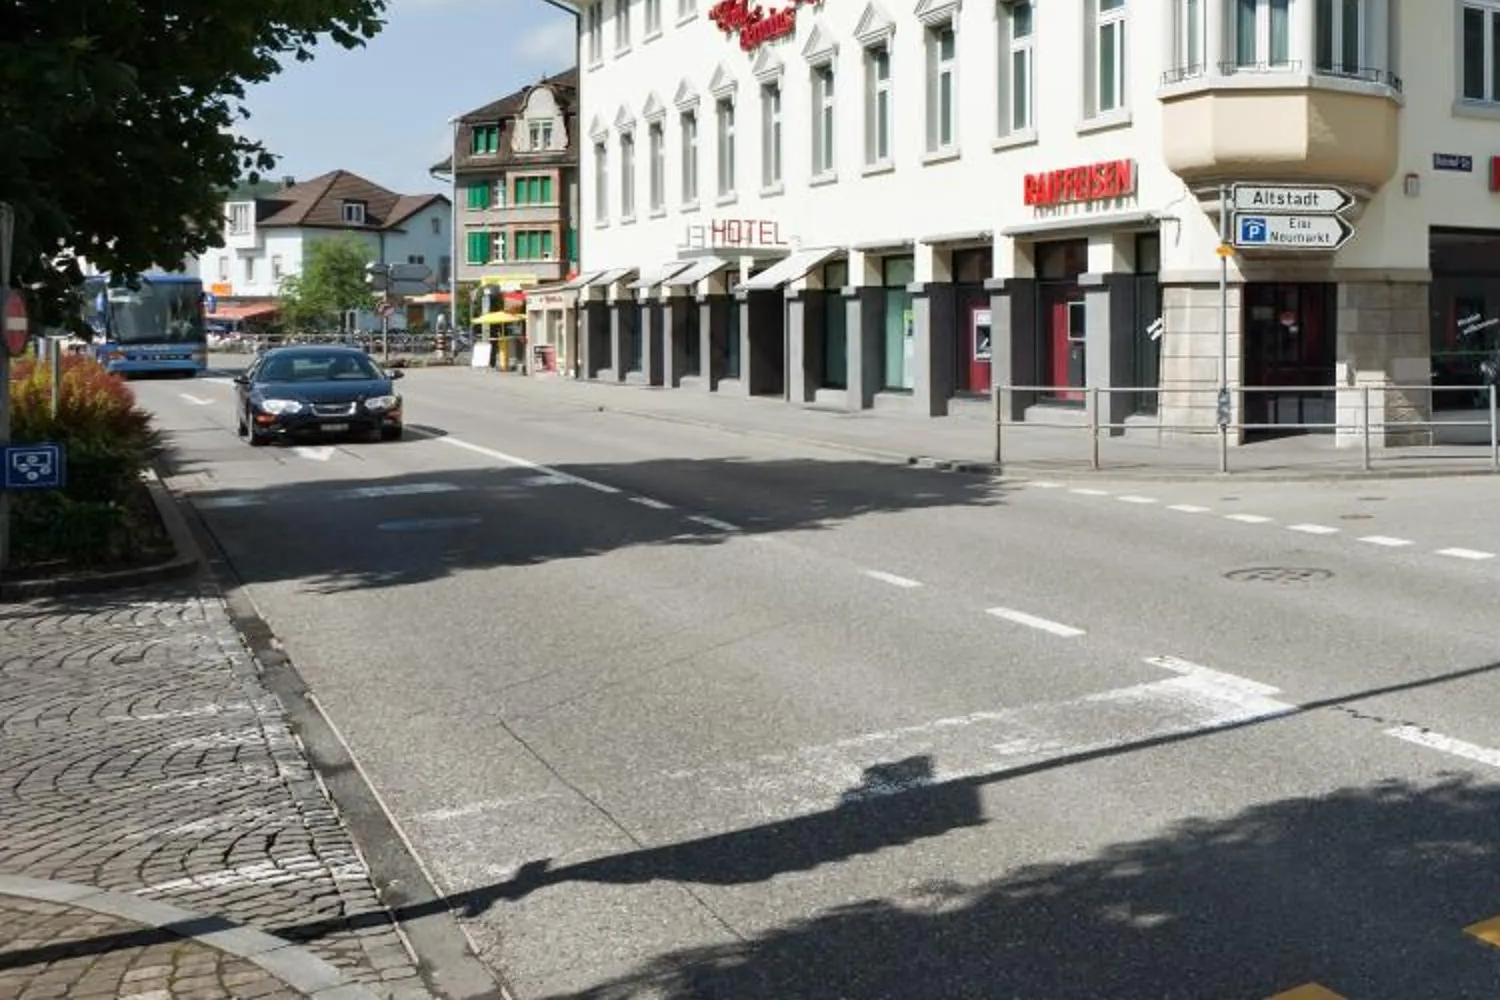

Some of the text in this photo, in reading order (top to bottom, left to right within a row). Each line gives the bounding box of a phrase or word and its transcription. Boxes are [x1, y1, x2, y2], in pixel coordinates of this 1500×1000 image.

[1023, 158, 1135, 207] RAIFFEISEN
[1252, 191, 1320, 206] Altstadt
[711, 218, 789, 246] HOTEL
[1271, 231, 1330, 243] Neumarkt
